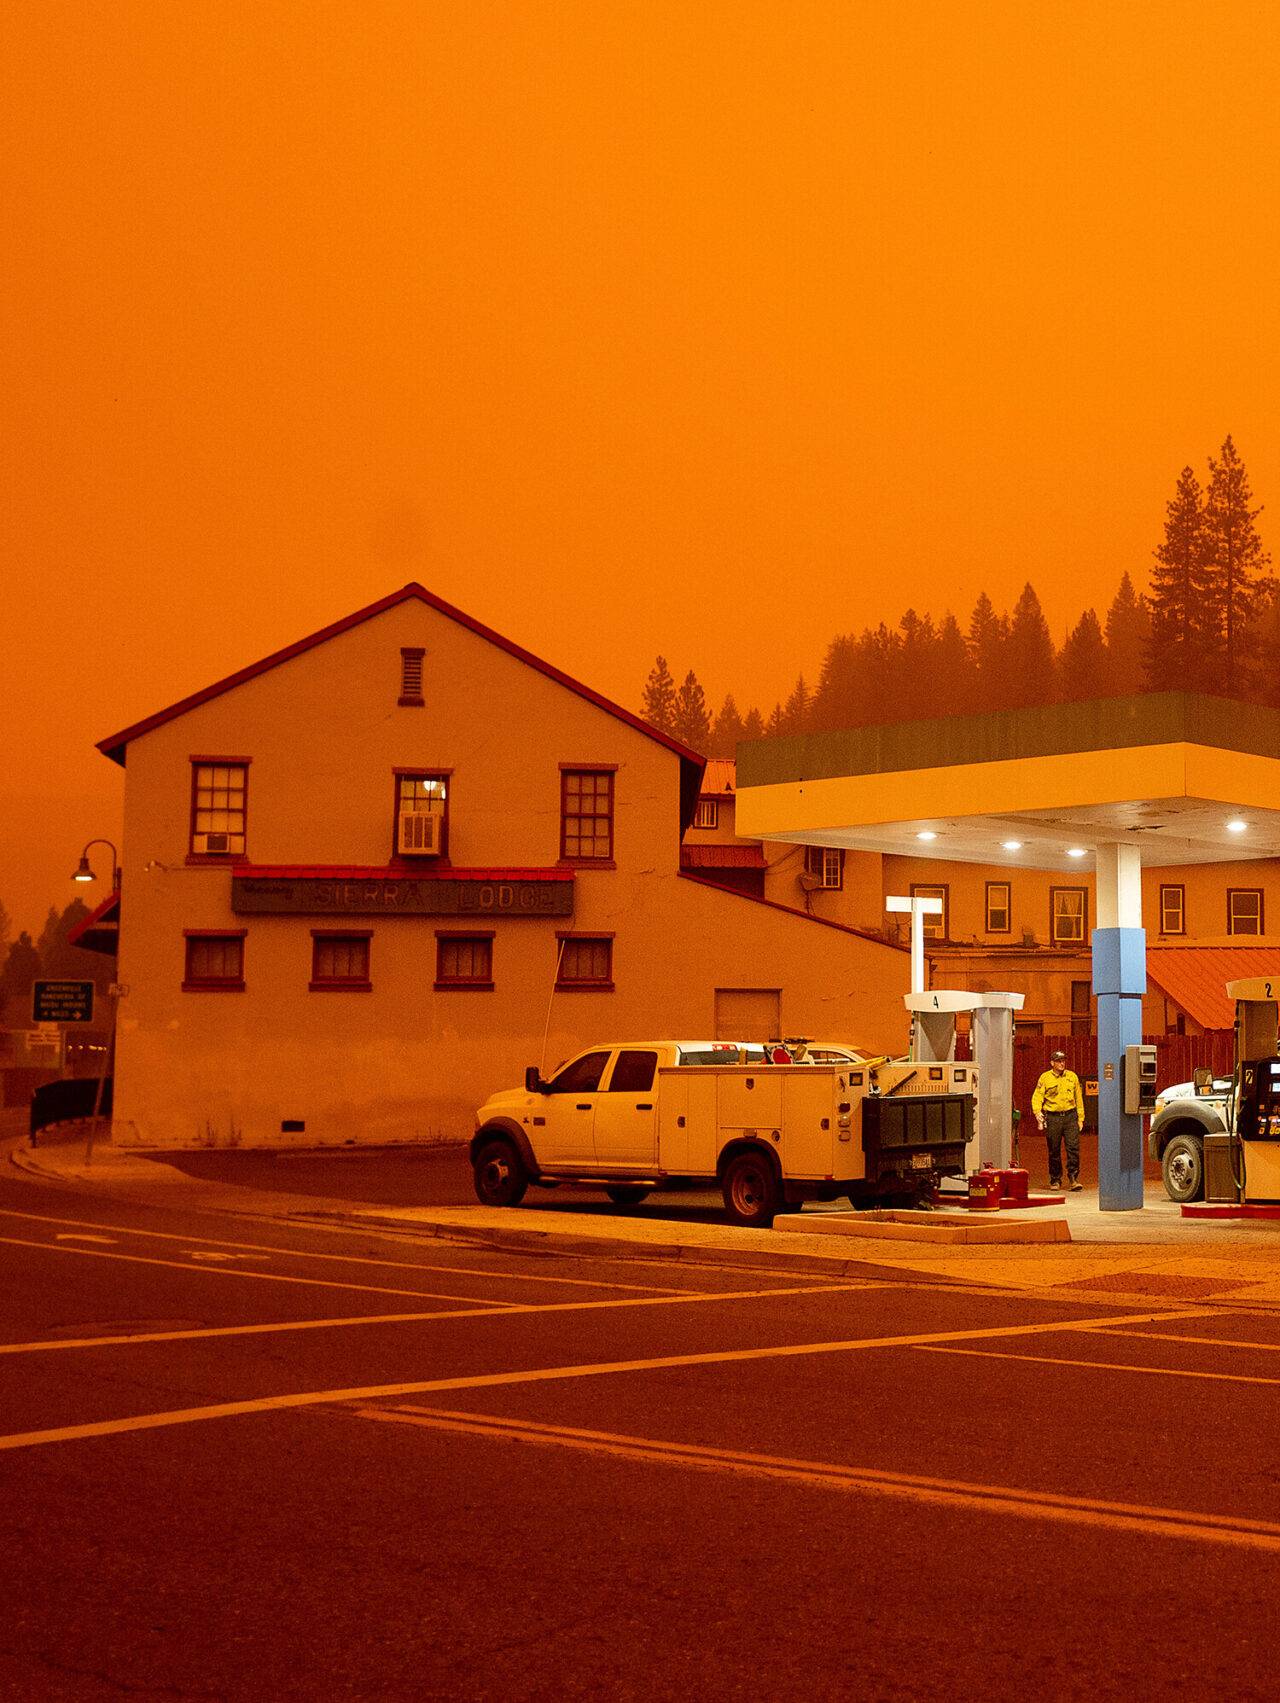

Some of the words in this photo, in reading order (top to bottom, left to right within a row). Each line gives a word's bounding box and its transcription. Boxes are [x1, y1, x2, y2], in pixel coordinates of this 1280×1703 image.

[313, 885, 424, 907] SIERRA
[457, 885, 556, 909] LODGE
[1265, 983, 1273, 998] 2
[933, 996, 939, 1009] 4
